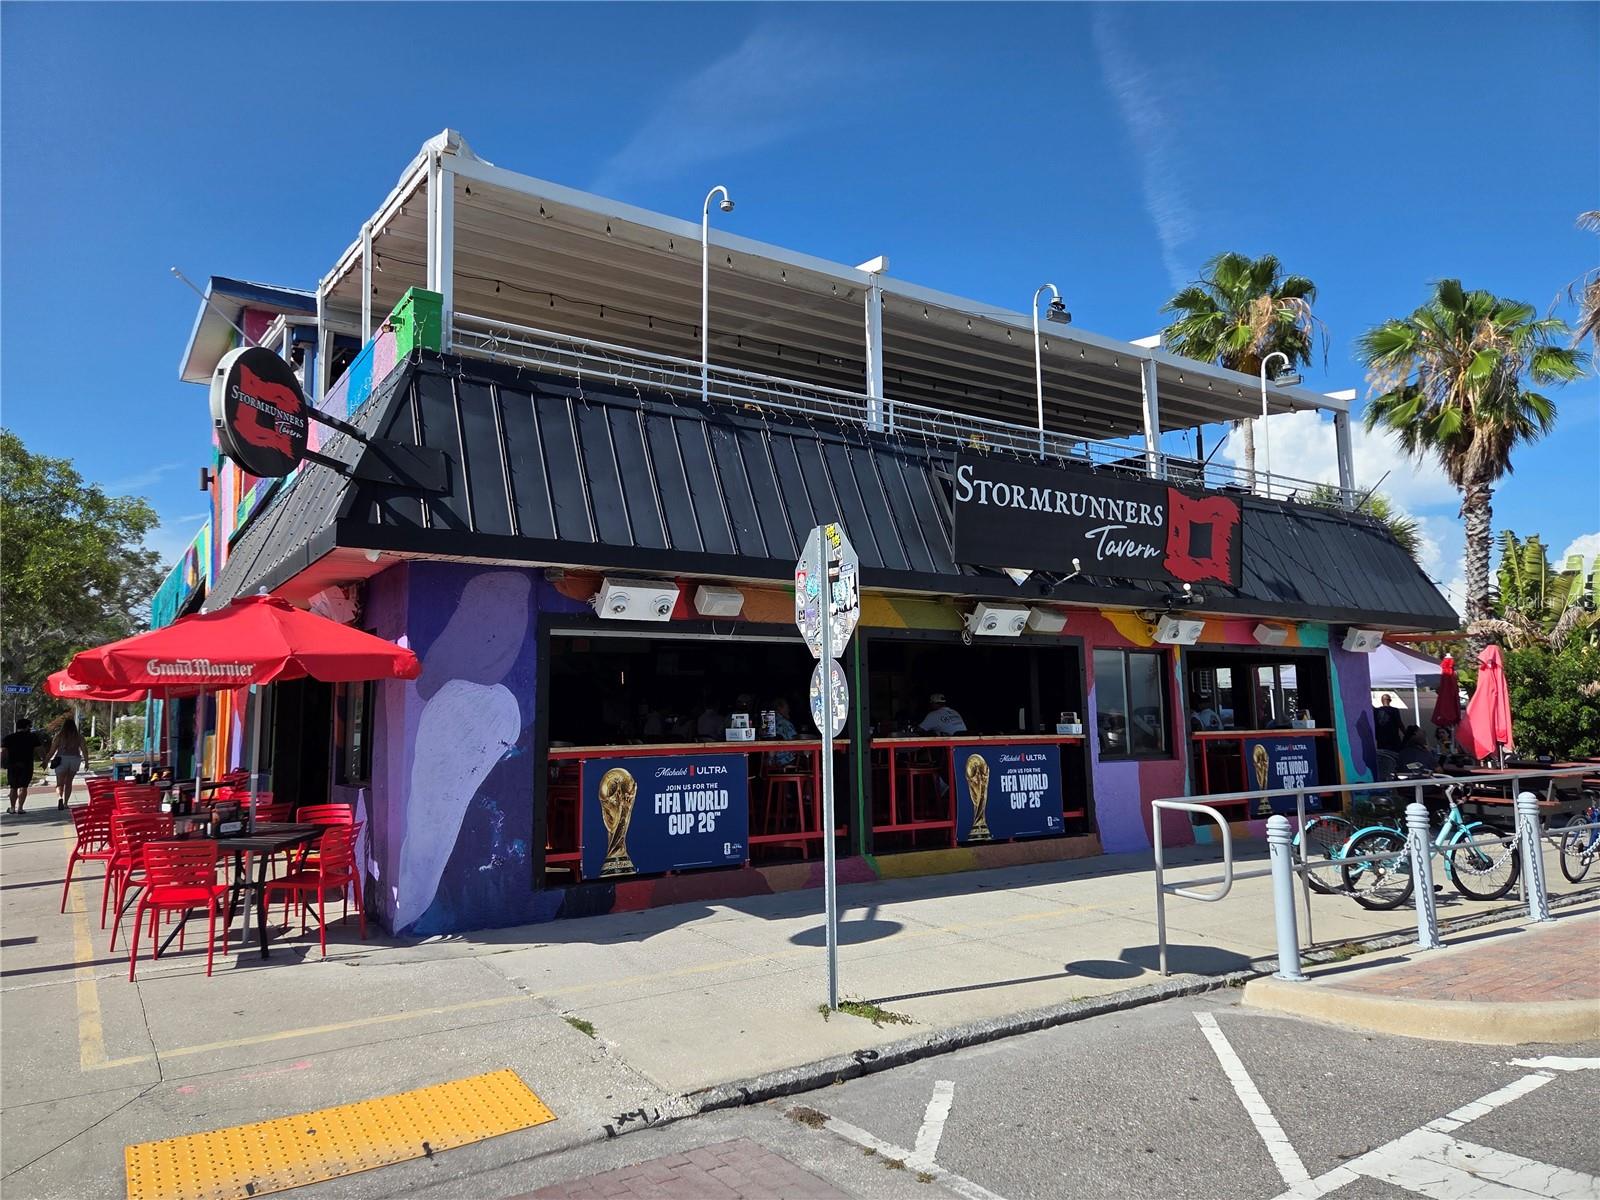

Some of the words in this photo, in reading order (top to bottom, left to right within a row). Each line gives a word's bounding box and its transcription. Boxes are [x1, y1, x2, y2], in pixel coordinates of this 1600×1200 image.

[231, 385, 304, 428] STORMRUNNERS
[275, 421, 302, 438] Tavern
[955, 465, 1163, 527] STORMRUNNERS
[1085, 525, 1160, 560] Tavern
[655, 767, 688, 778] Michelob
[696, 766, 728, 774] ULTRA
[1289, 761, 1308, 774] WORLD
[665, 784, 681, 792] JOIN
[1000, 775, 1018, 792] FIFA
[1019, 773, 1049, 791] WORLD
[654, 792, 681, 814] FIFA
[684, 790, 729, 812] WORLD
[1010, 792, 1027, 809] CUP
[668, 813, 695, 836] CUP
